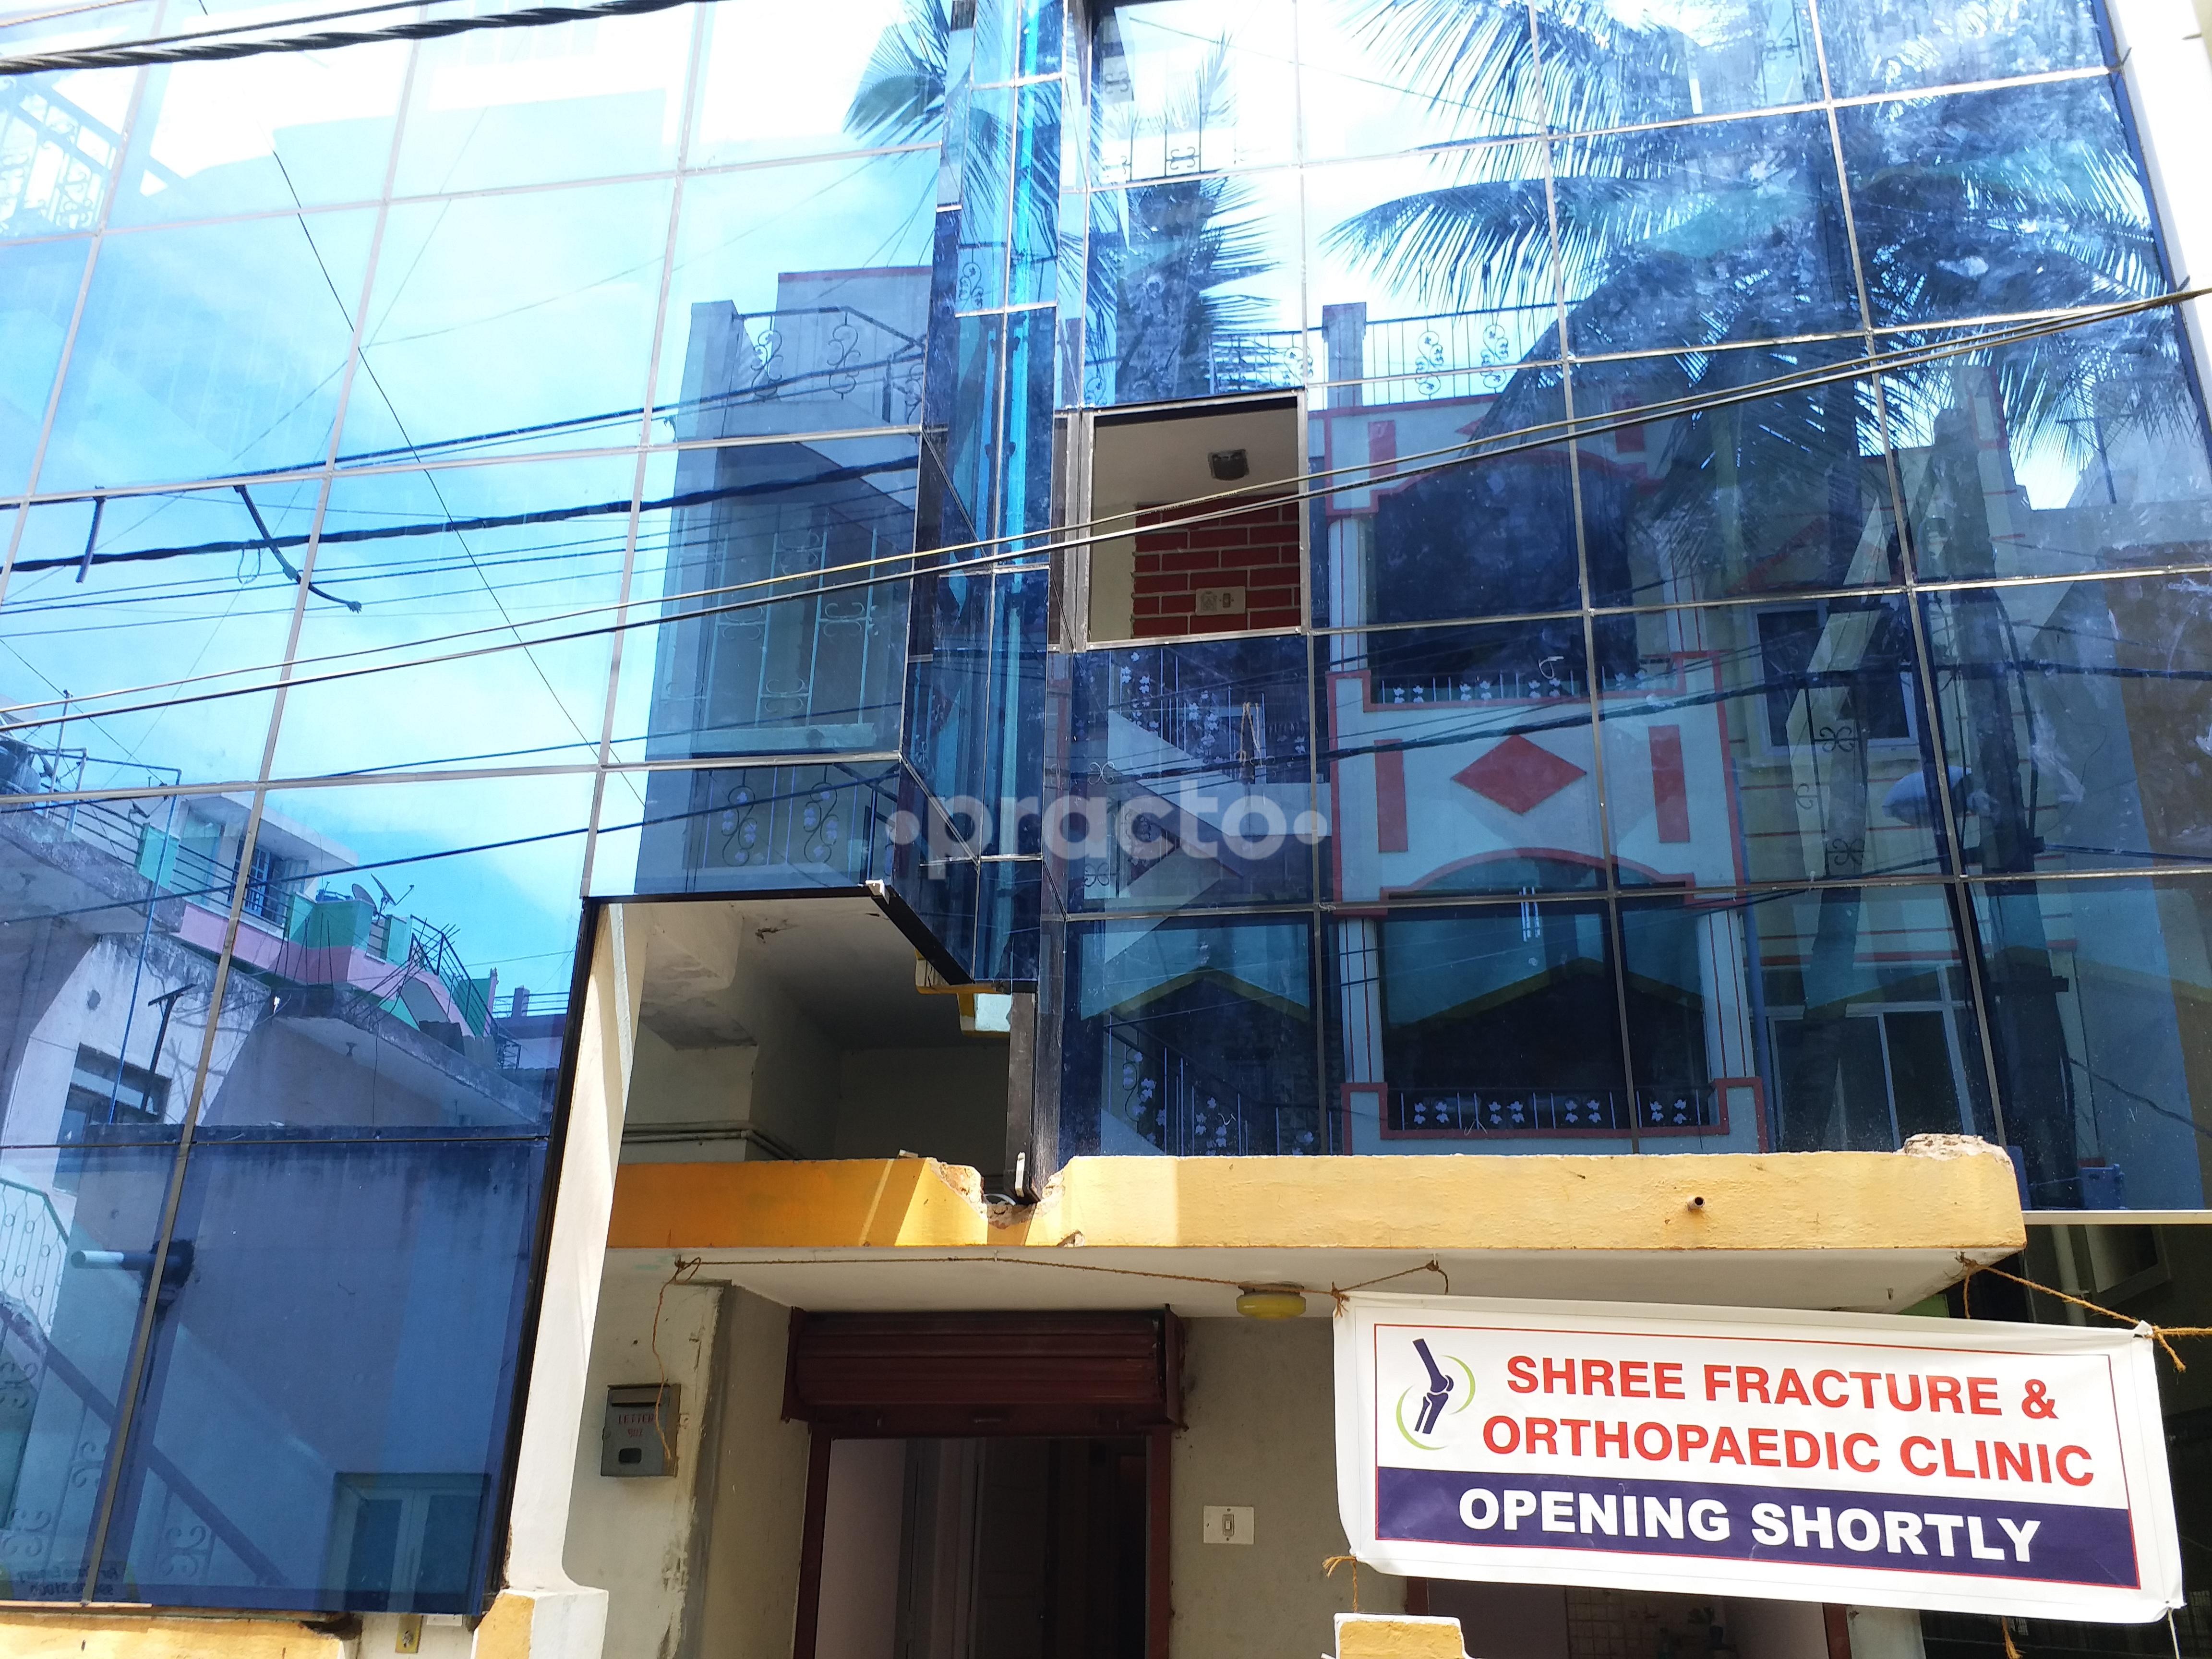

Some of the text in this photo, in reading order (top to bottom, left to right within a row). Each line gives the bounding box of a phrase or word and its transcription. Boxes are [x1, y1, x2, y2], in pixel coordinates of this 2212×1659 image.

[1507, 1355, 2057, 1419] SHREE FRACTURE &
[1482, 1415, 2094, 1487] ORTHOPAEDIC CLINIC
[1459, 1488, 2041, 1563] OPENING SHORTLY
